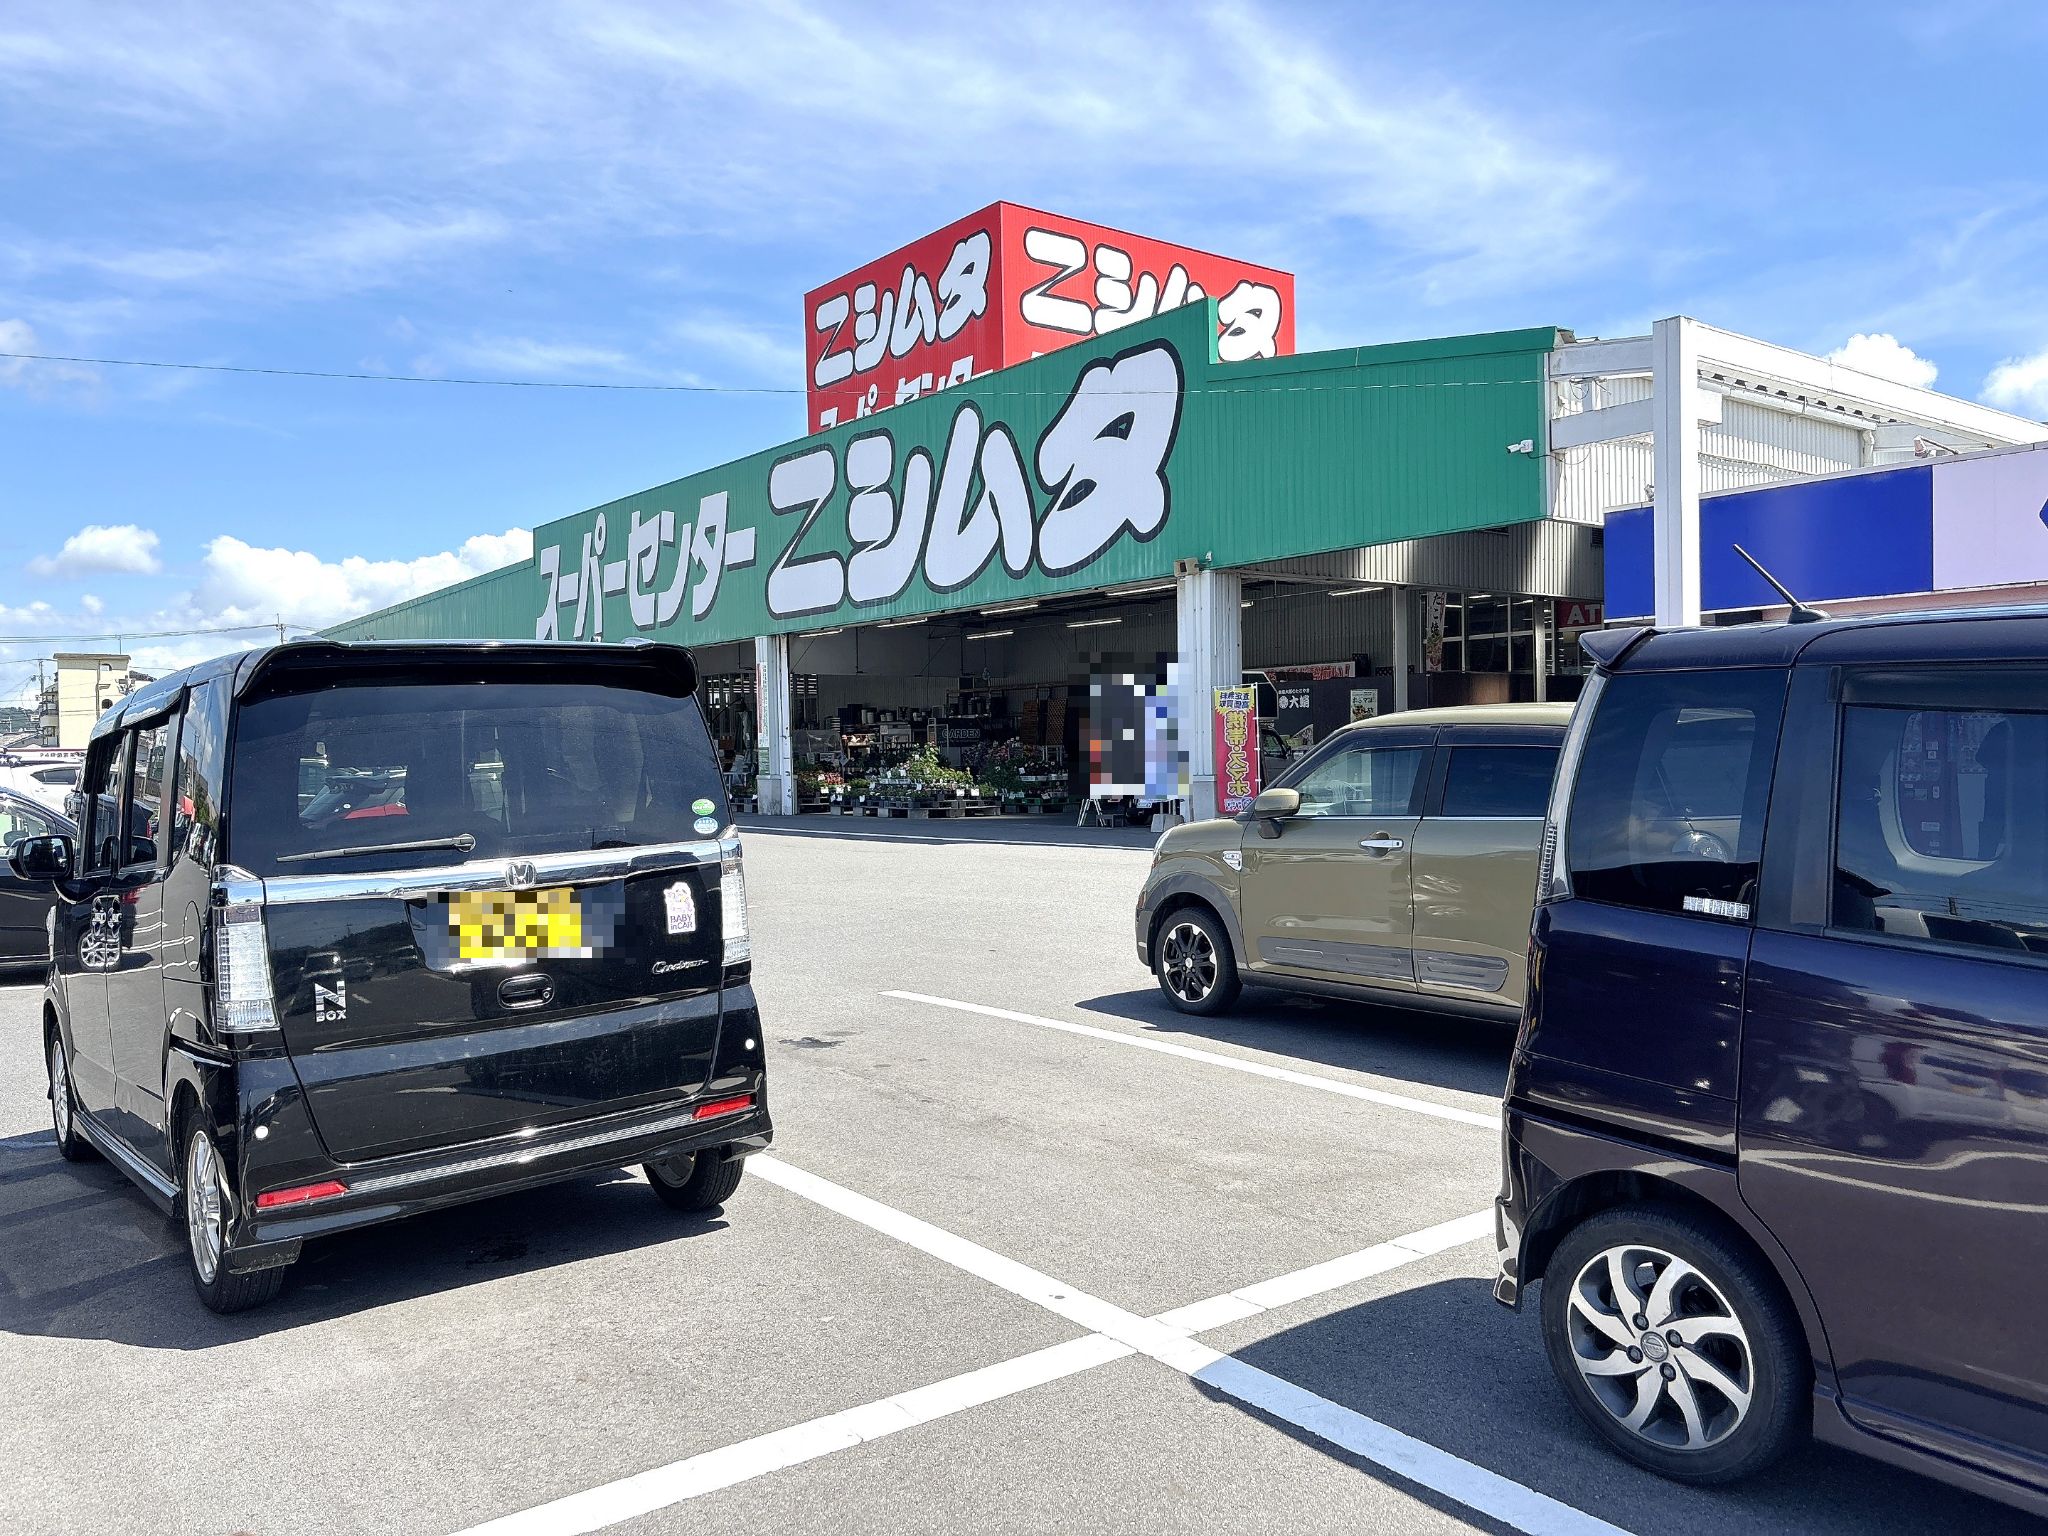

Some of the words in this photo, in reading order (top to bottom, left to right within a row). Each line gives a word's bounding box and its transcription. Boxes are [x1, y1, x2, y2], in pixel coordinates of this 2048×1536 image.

[814, 229, 992, 389] ニシムタ
[536, 490, 756, 640] スーパーセンター
[765, 338, 1184, 619] ニシムタ
[942, 728, 981, 739] GARDEN
[670, 914, 693, 923] BABY
[315, 980, 346, 1011] N
[316, 1010, 347, 1022] BOX
